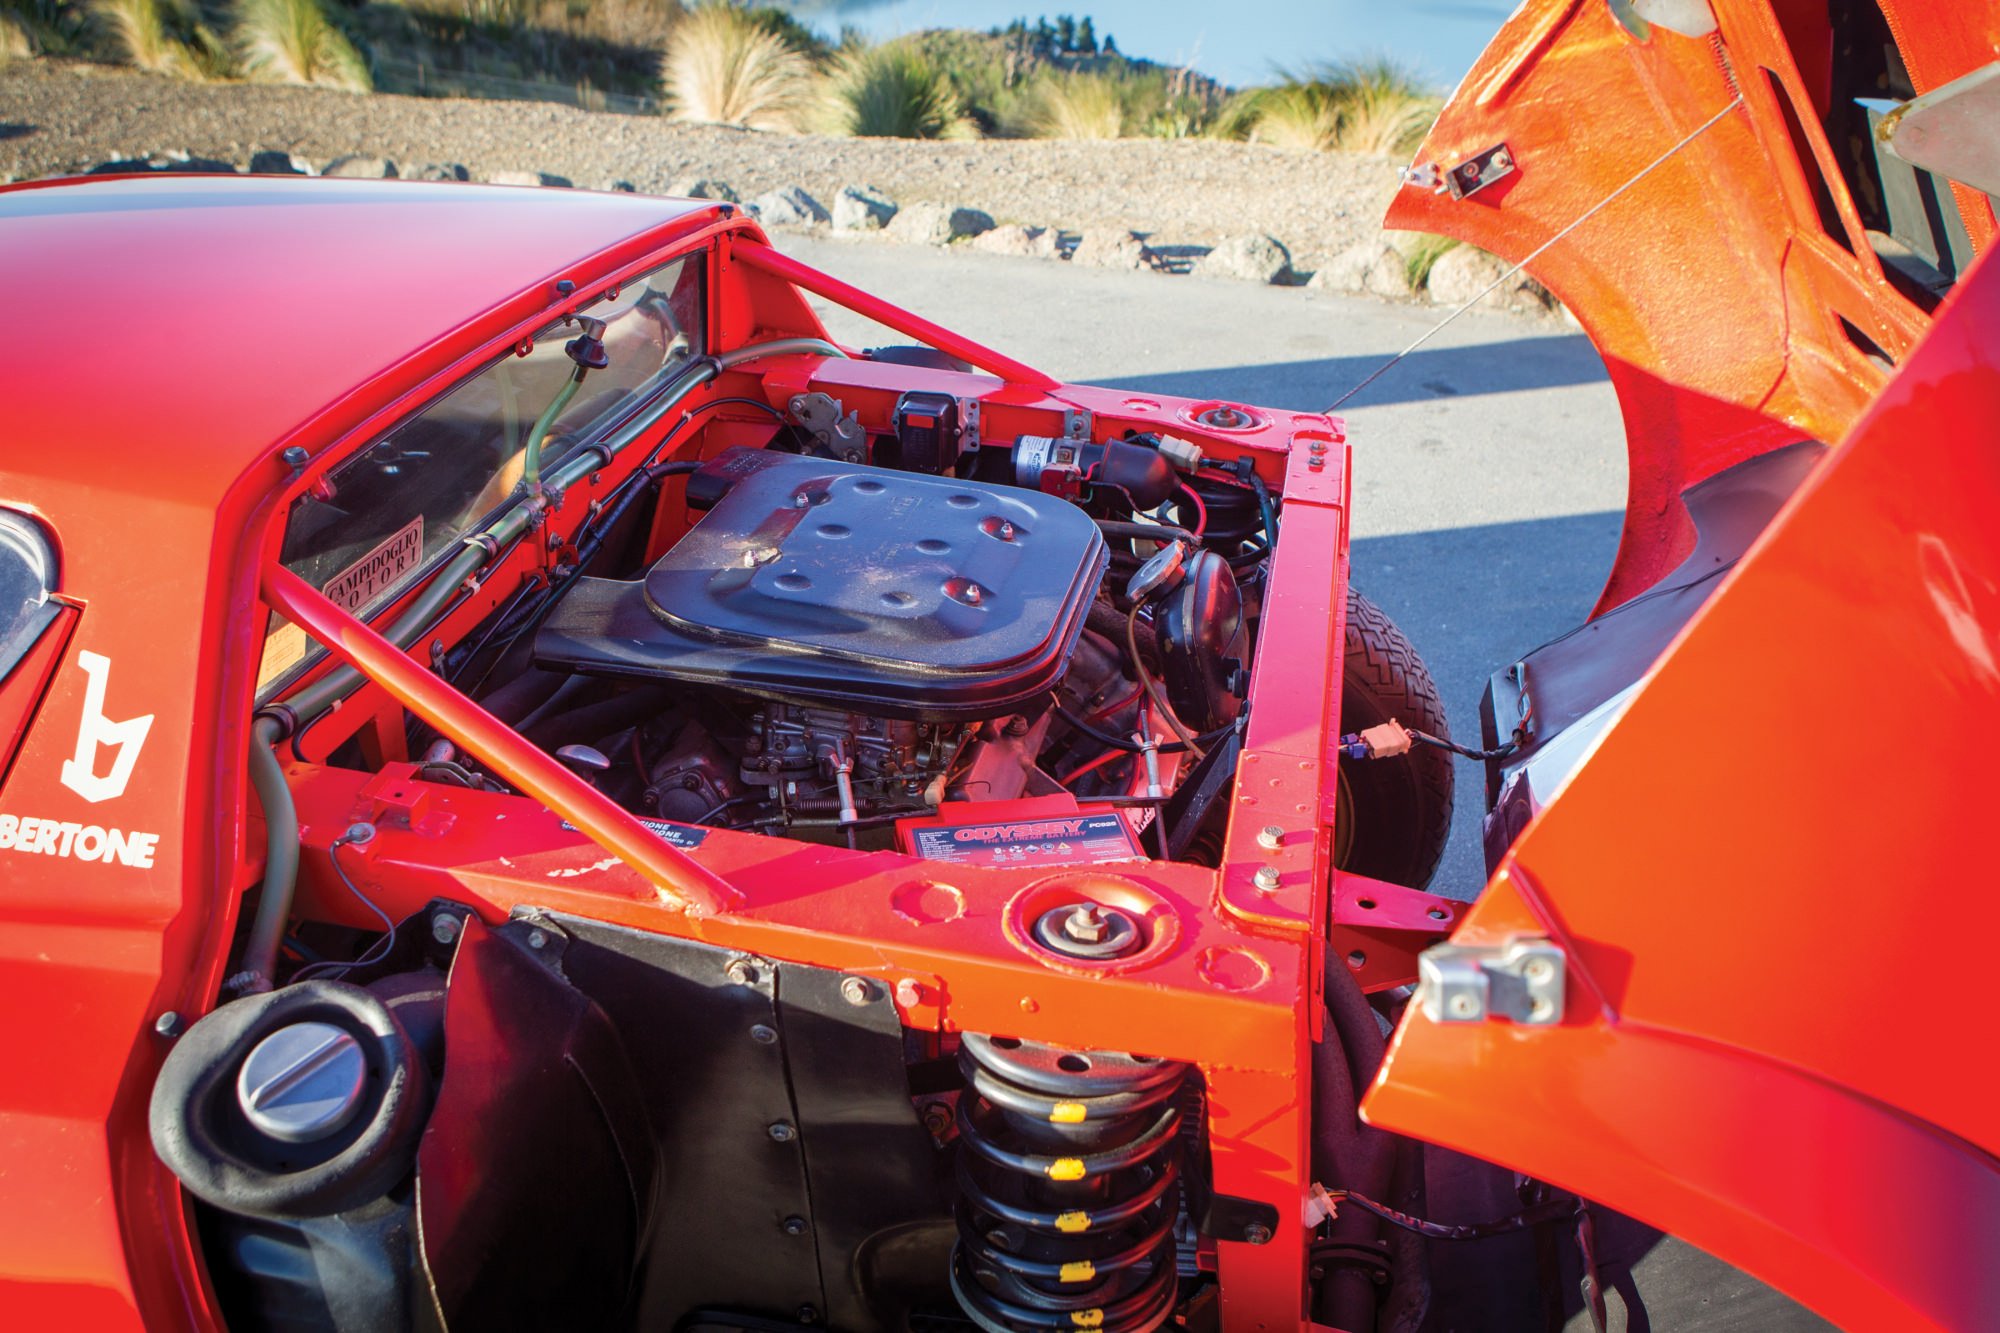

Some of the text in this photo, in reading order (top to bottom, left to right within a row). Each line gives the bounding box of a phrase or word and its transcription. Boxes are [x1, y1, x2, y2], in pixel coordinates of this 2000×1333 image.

[329, 529, 418, 600] CAMPIDOGLIO
[338, 547, 416, 608] OTORI
[0, 814, 160, 869] BERTONE
[954, 820, 1084, 842] ODYSSEY
